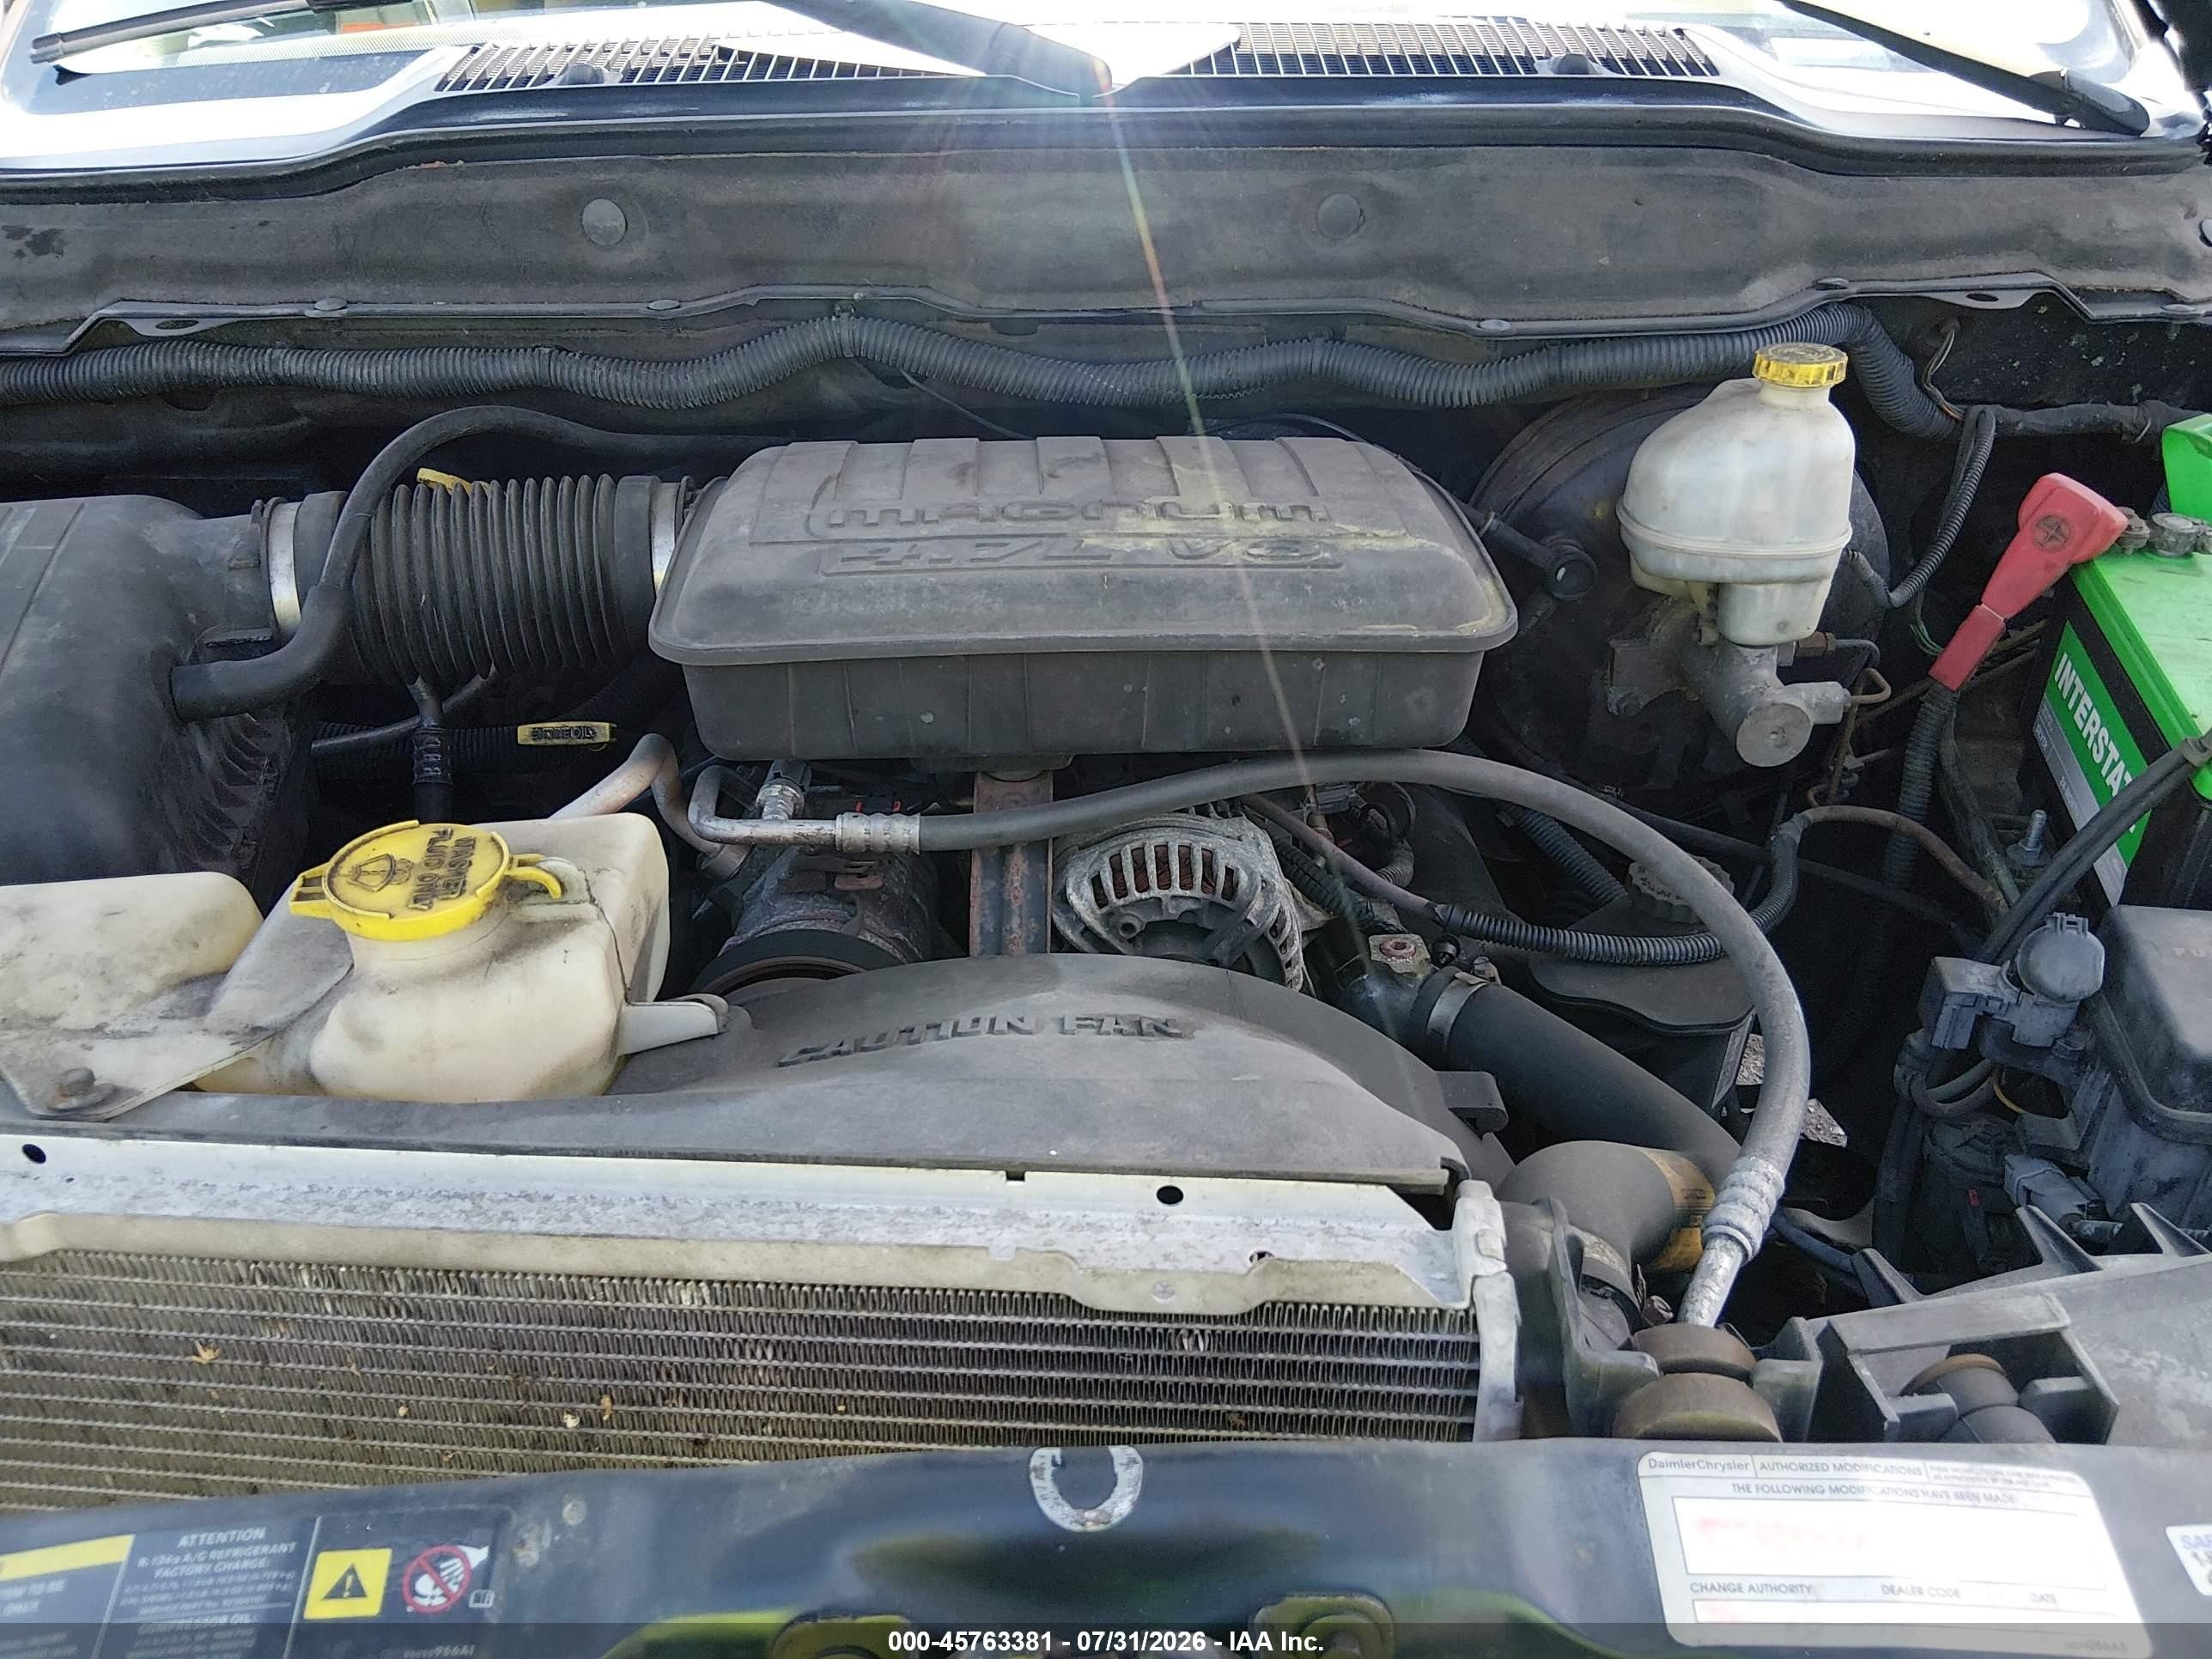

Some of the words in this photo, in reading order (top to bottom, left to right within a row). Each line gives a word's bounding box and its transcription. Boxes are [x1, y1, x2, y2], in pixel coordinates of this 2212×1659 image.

[422, 826, 453, 870] FLUID
[436, 835, 477, 900] WASHER
[408, 872, 441, 910] ONLY
[777, 1014, 1035, 1067] CAUTION
[1059, 1013, 1197, 1040] FAN
[1648, 1458, 1749, 1472] DaimlerChrysler
[1759, 1462, 1829, 1473] AUTHORIZED
[1731, 1483, 1752, 1493] THE
[1755, 1484, 1826, 1495] FOLLOWING
[177, 1526, 267, 1548] ATTENTION
[209, 1541, 297, 1560] REFRIGERANT
[1690, 1583, 1744, 1594] CHANGE
